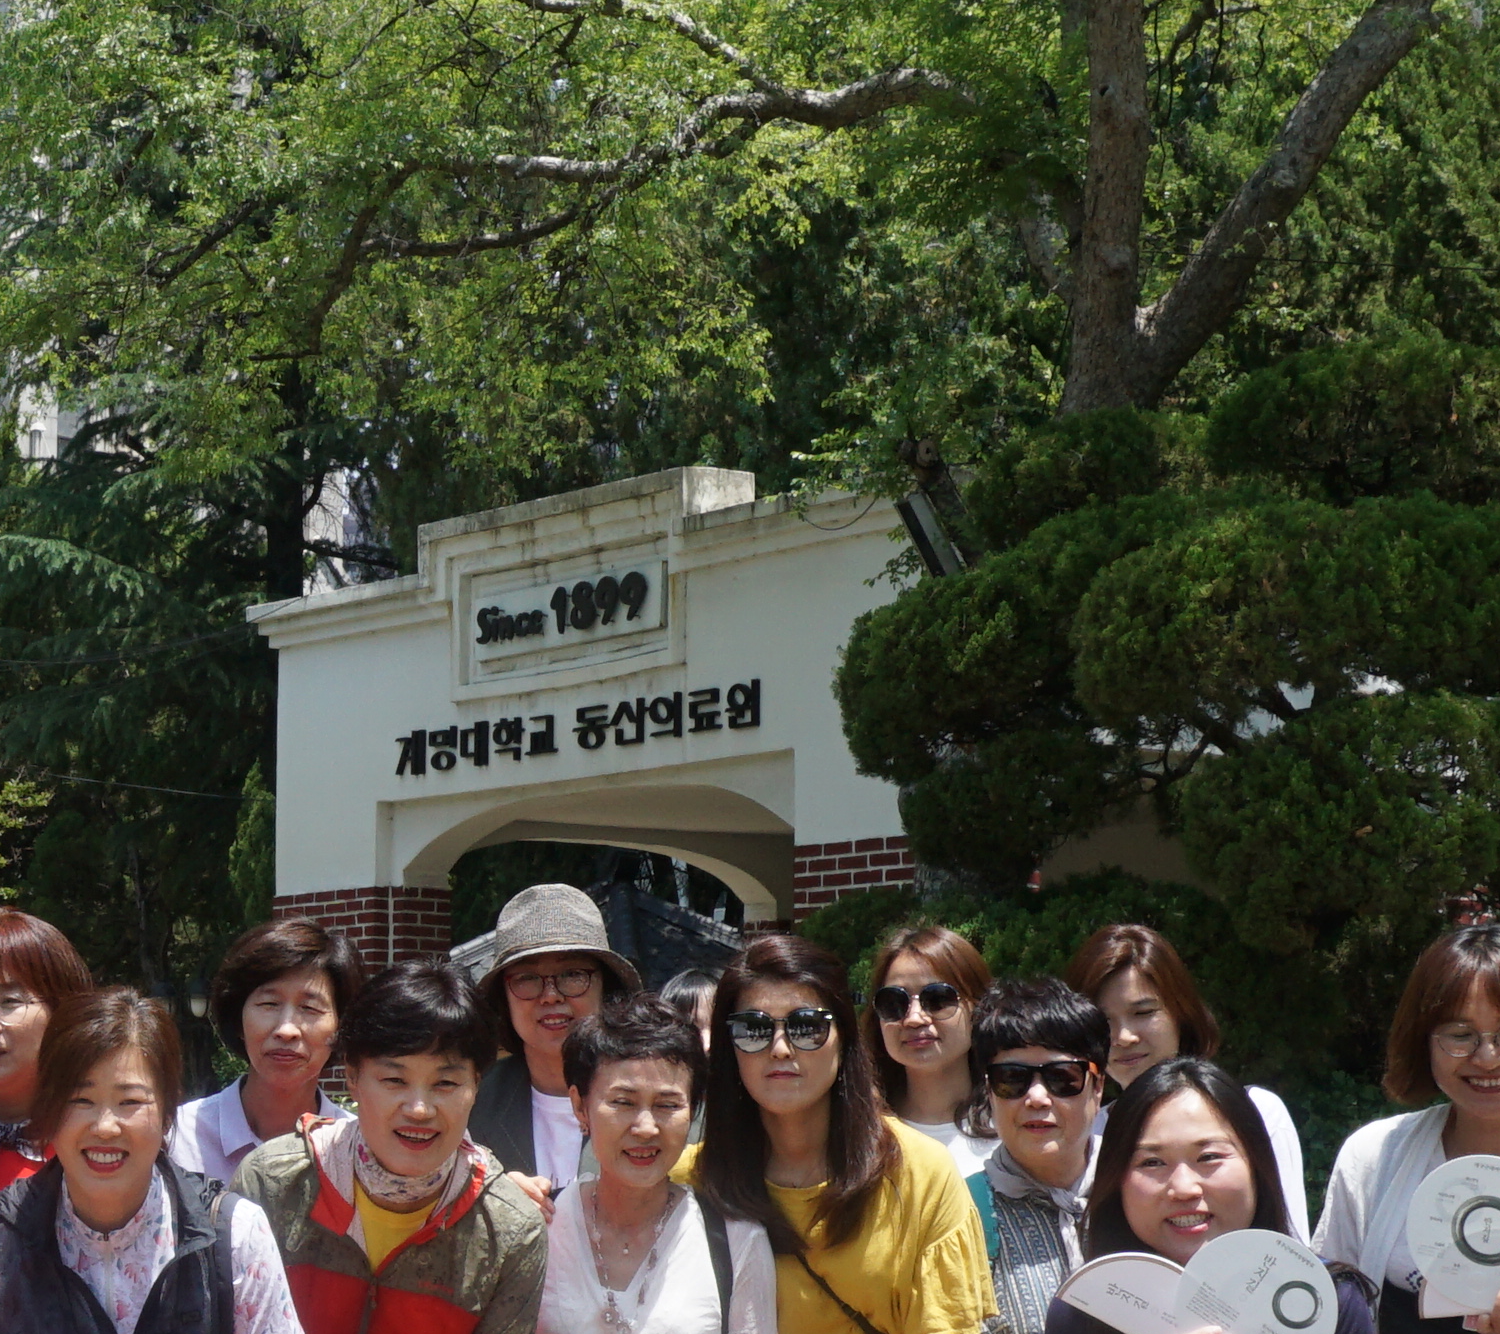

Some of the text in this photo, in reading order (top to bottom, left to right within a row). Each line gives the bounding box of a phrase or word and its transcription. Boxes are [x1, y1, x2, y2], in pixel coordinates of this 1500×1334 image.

[476, 571, 648, 645] Since 1899
[395, 678, 761, 776] 계명대학교 동산의료원
[1106, 1282, 1150, 1310] 반지길
[1245, 1254, 1277, 1294] 반지길
